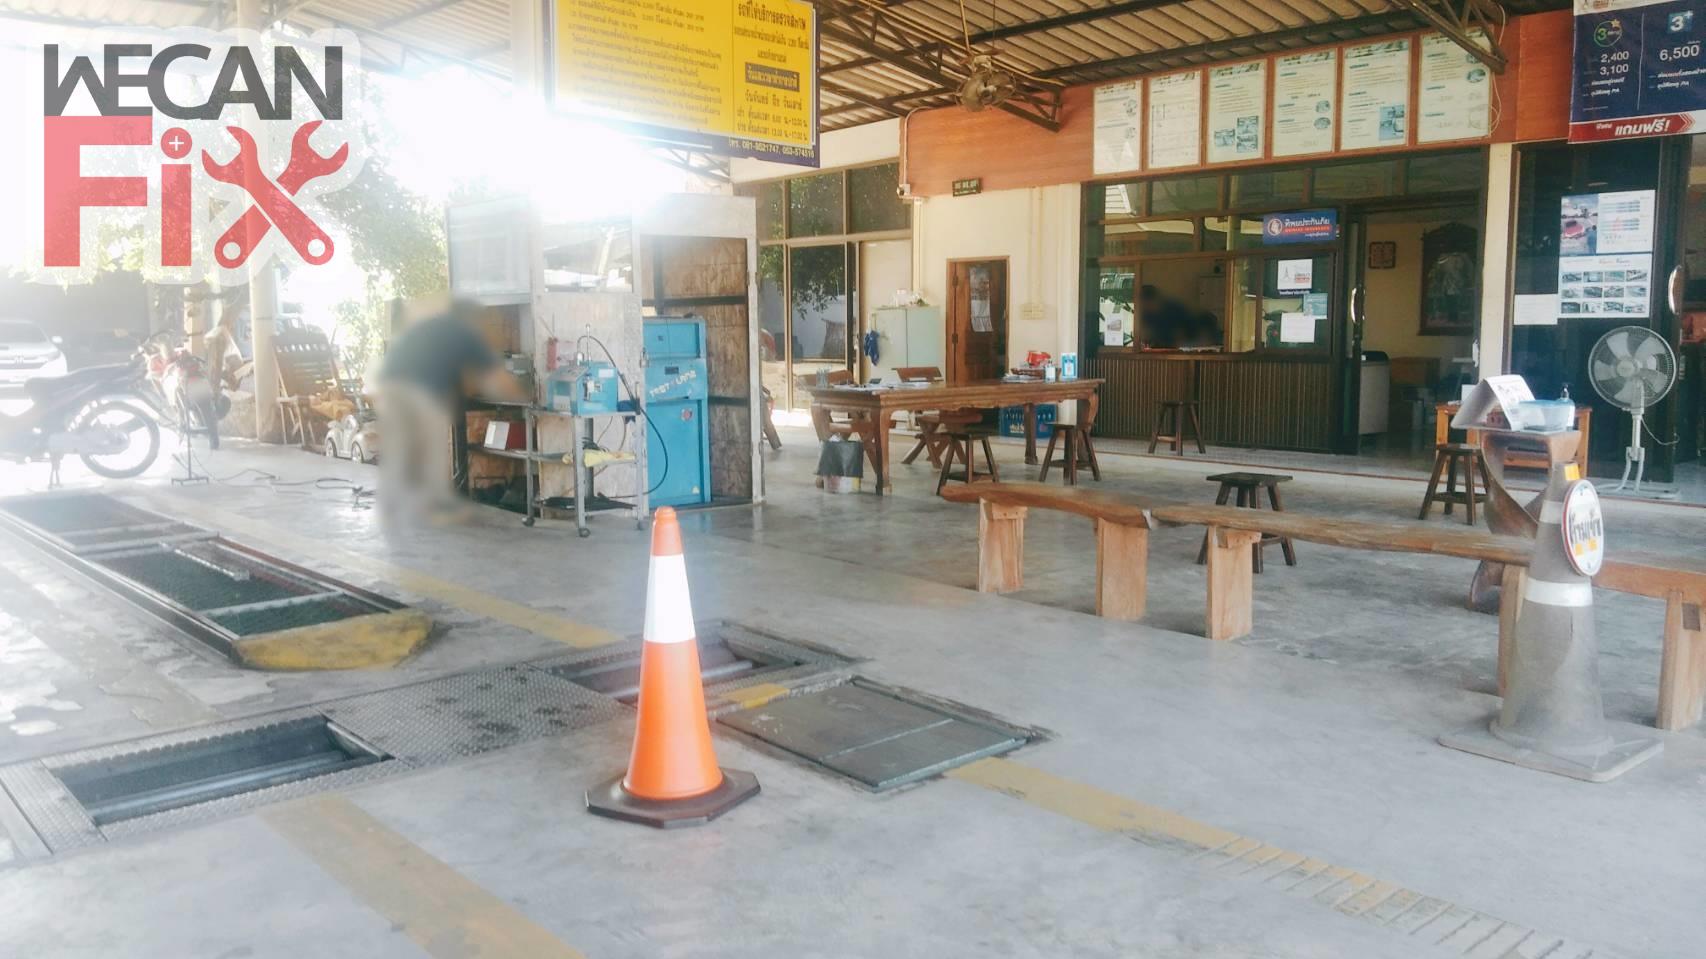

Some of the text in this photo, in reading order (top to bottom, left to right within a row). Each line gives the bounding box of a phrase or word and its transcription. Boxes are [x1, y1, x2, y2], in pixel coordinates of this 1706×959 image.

[1601, 51, 1630, 63] 2,400
[1659, 44, 1700, 61] 6,500
[1600, 64, 1629, 76] 3,100
[1615, 117, 1670, 137] แถมฟรี!
